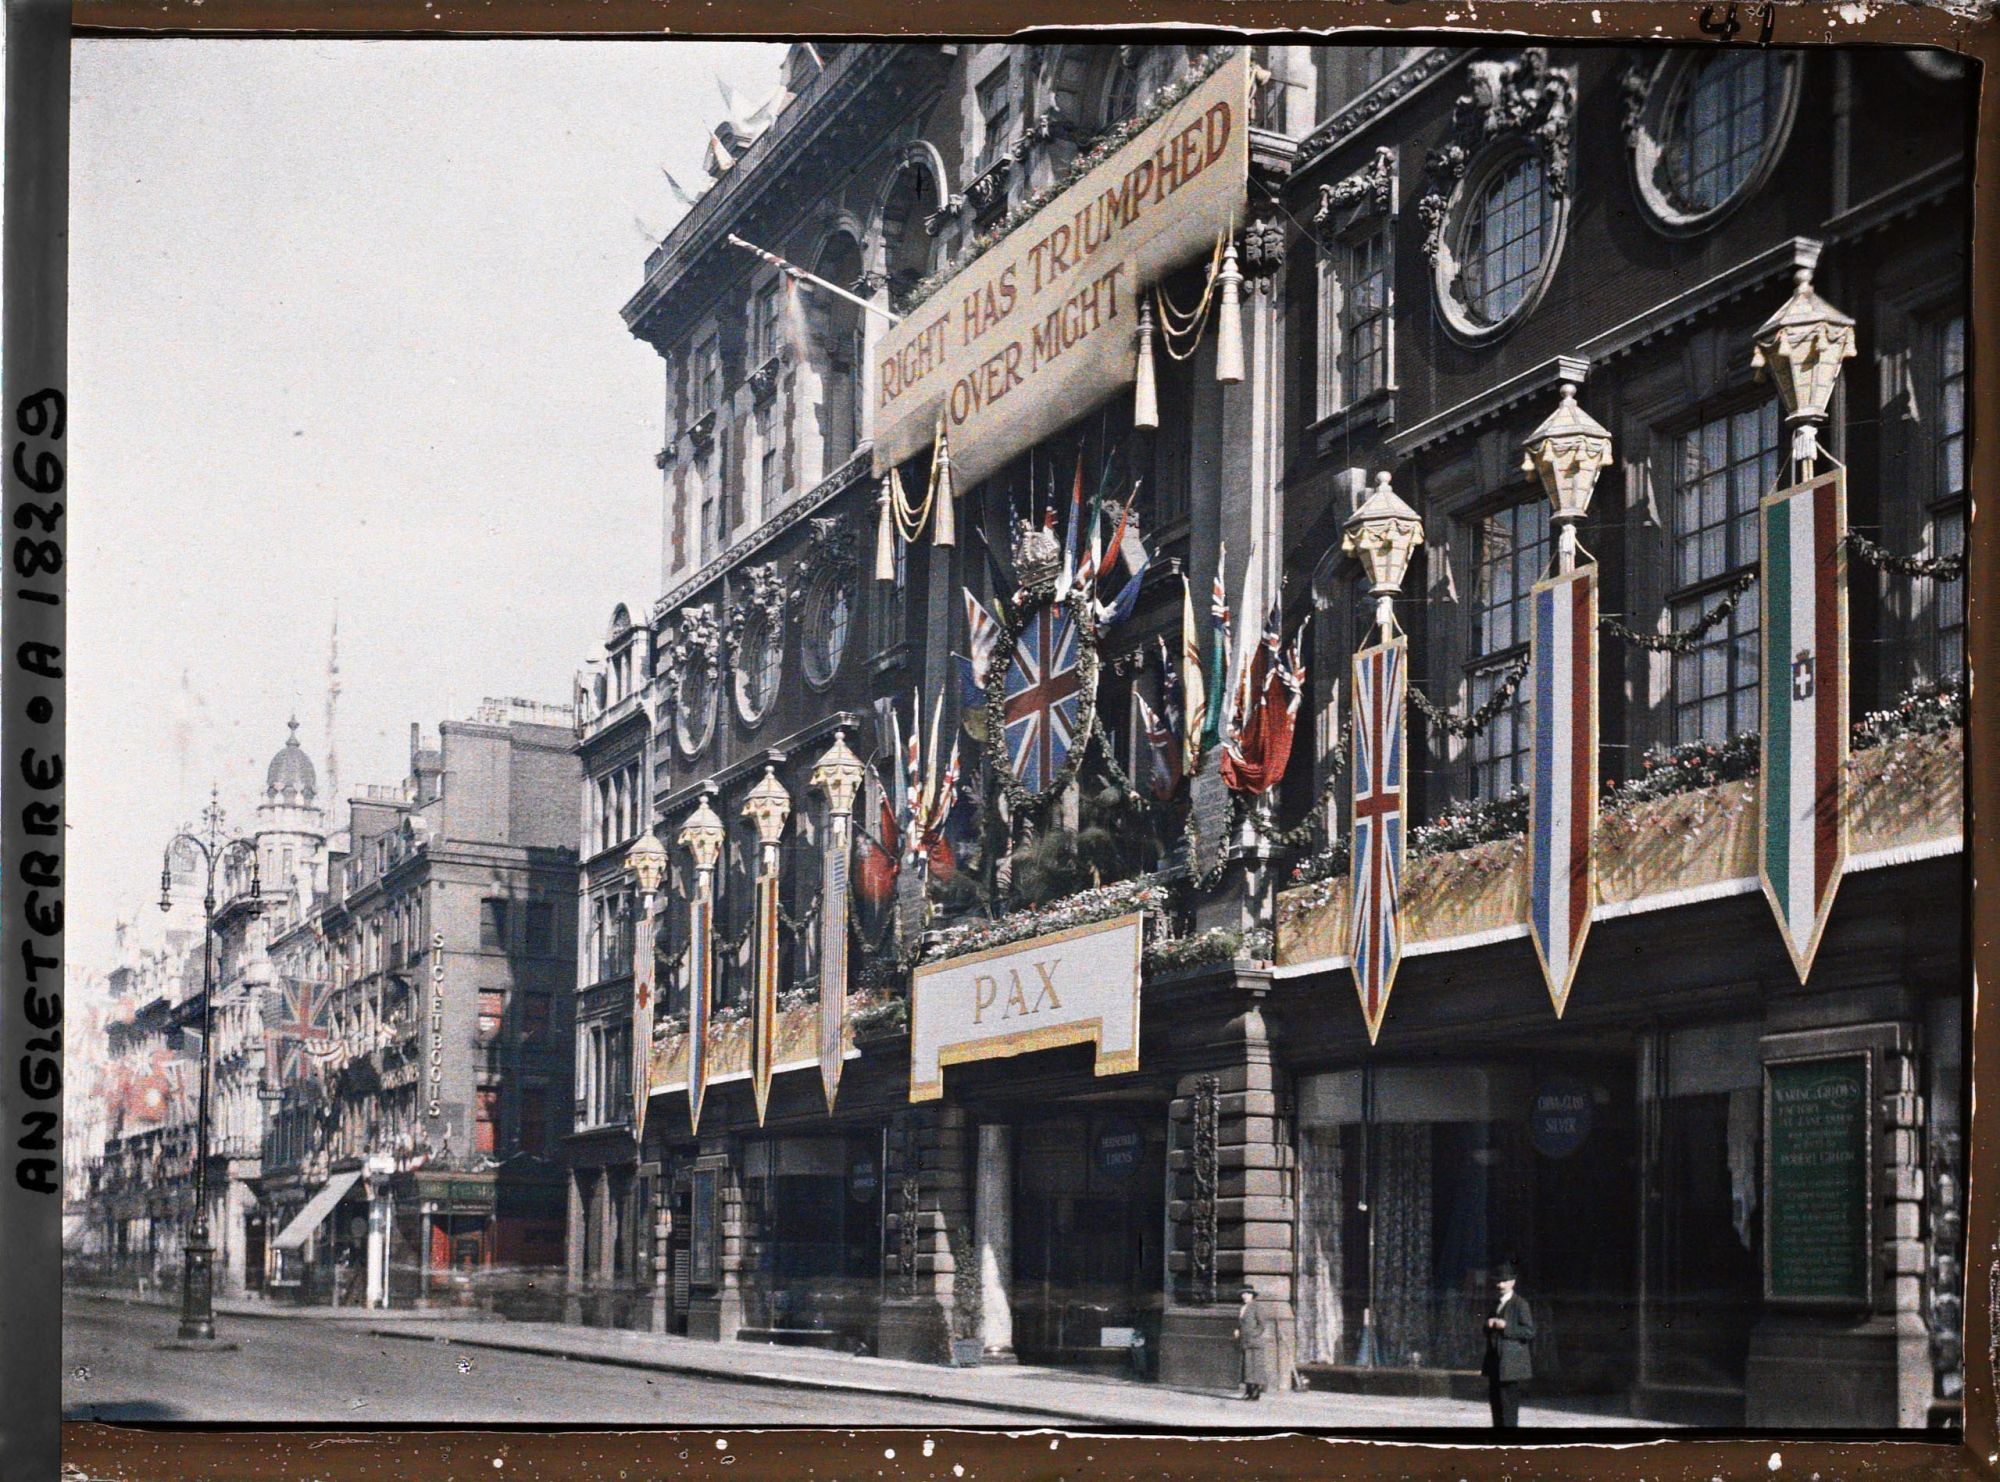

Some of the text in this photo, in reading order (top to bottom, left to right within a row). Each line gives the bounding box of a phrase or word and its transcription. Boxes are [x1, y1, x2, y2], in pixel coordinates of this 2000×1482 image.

[880, 101, 1231, 407] RIGHT HAS TRIUMPHED
[951, 261, 1125, 426] OVER MIGHT
[13, 388, 66, 1195] ANGLETERRE A 18269
[973, 958, 1062, 1024] PAX
[429, 1034, 443, 1115] BOOTS
